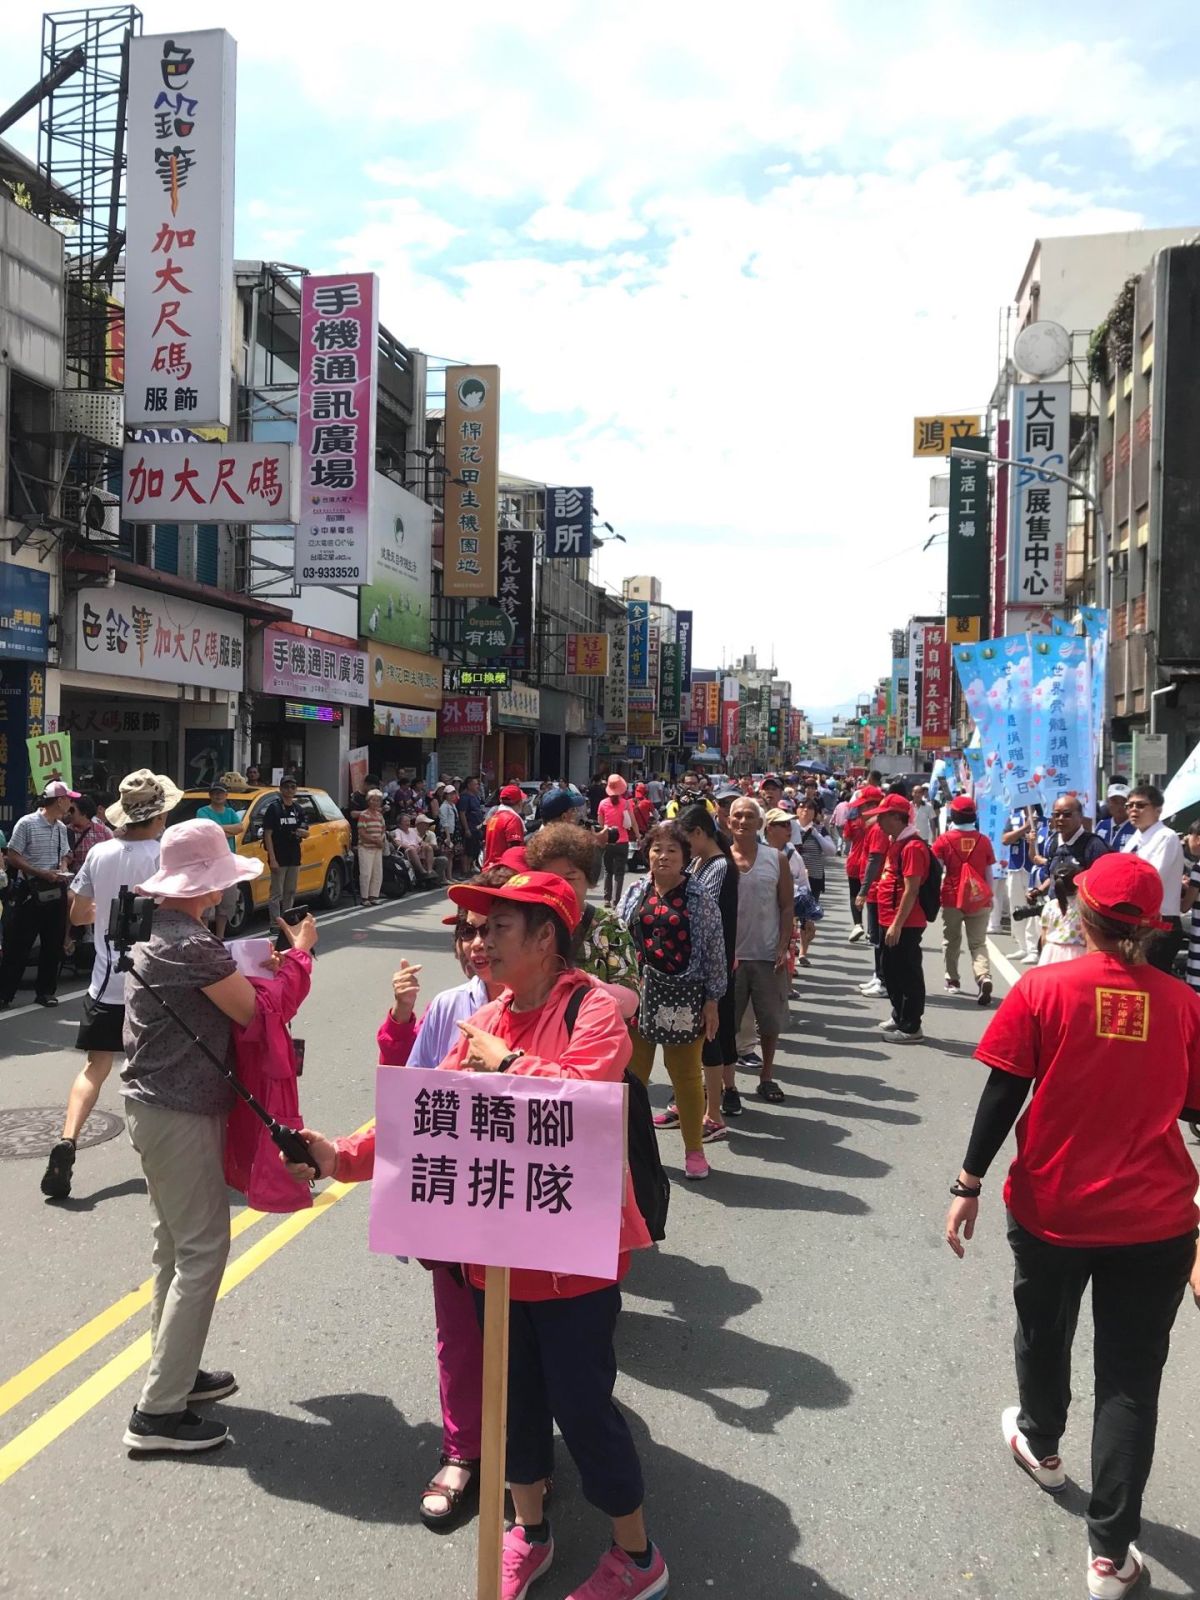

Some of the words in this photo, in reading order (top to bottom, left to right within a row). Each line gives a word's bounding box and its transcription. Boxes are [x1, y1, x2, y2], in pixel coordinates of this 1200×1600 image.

[144, 386, 198, 412] 服飾
[310, 283, 360, 491] 手機通訊廣場
[128, 457, 282, 507] 加大尺碼
[458, 421, 482, 575] 棉花田生機園地
[554, 489, 583, 553] 診所
[303, 567, 360, 578] 03-9333520
[82, 602, 241, 669] 色鉛筆加大尺碼服飾
[465, 631, 506, 646] 有機
[469, 617, 502, 627] Organic
[273, 641, 365, 685] 手機通訊廣場
[461, 671, 507, 684] 傷口換藥
[680, 622, 689, 680] Panasonic
[925, 631, 941, 733] 楊自順五金行
[442, 701, 484, 723] 外傷
[413, 1087, 573, 1147] 鑽轎腳
[410, 1153, 573, 1214] 請排隊
